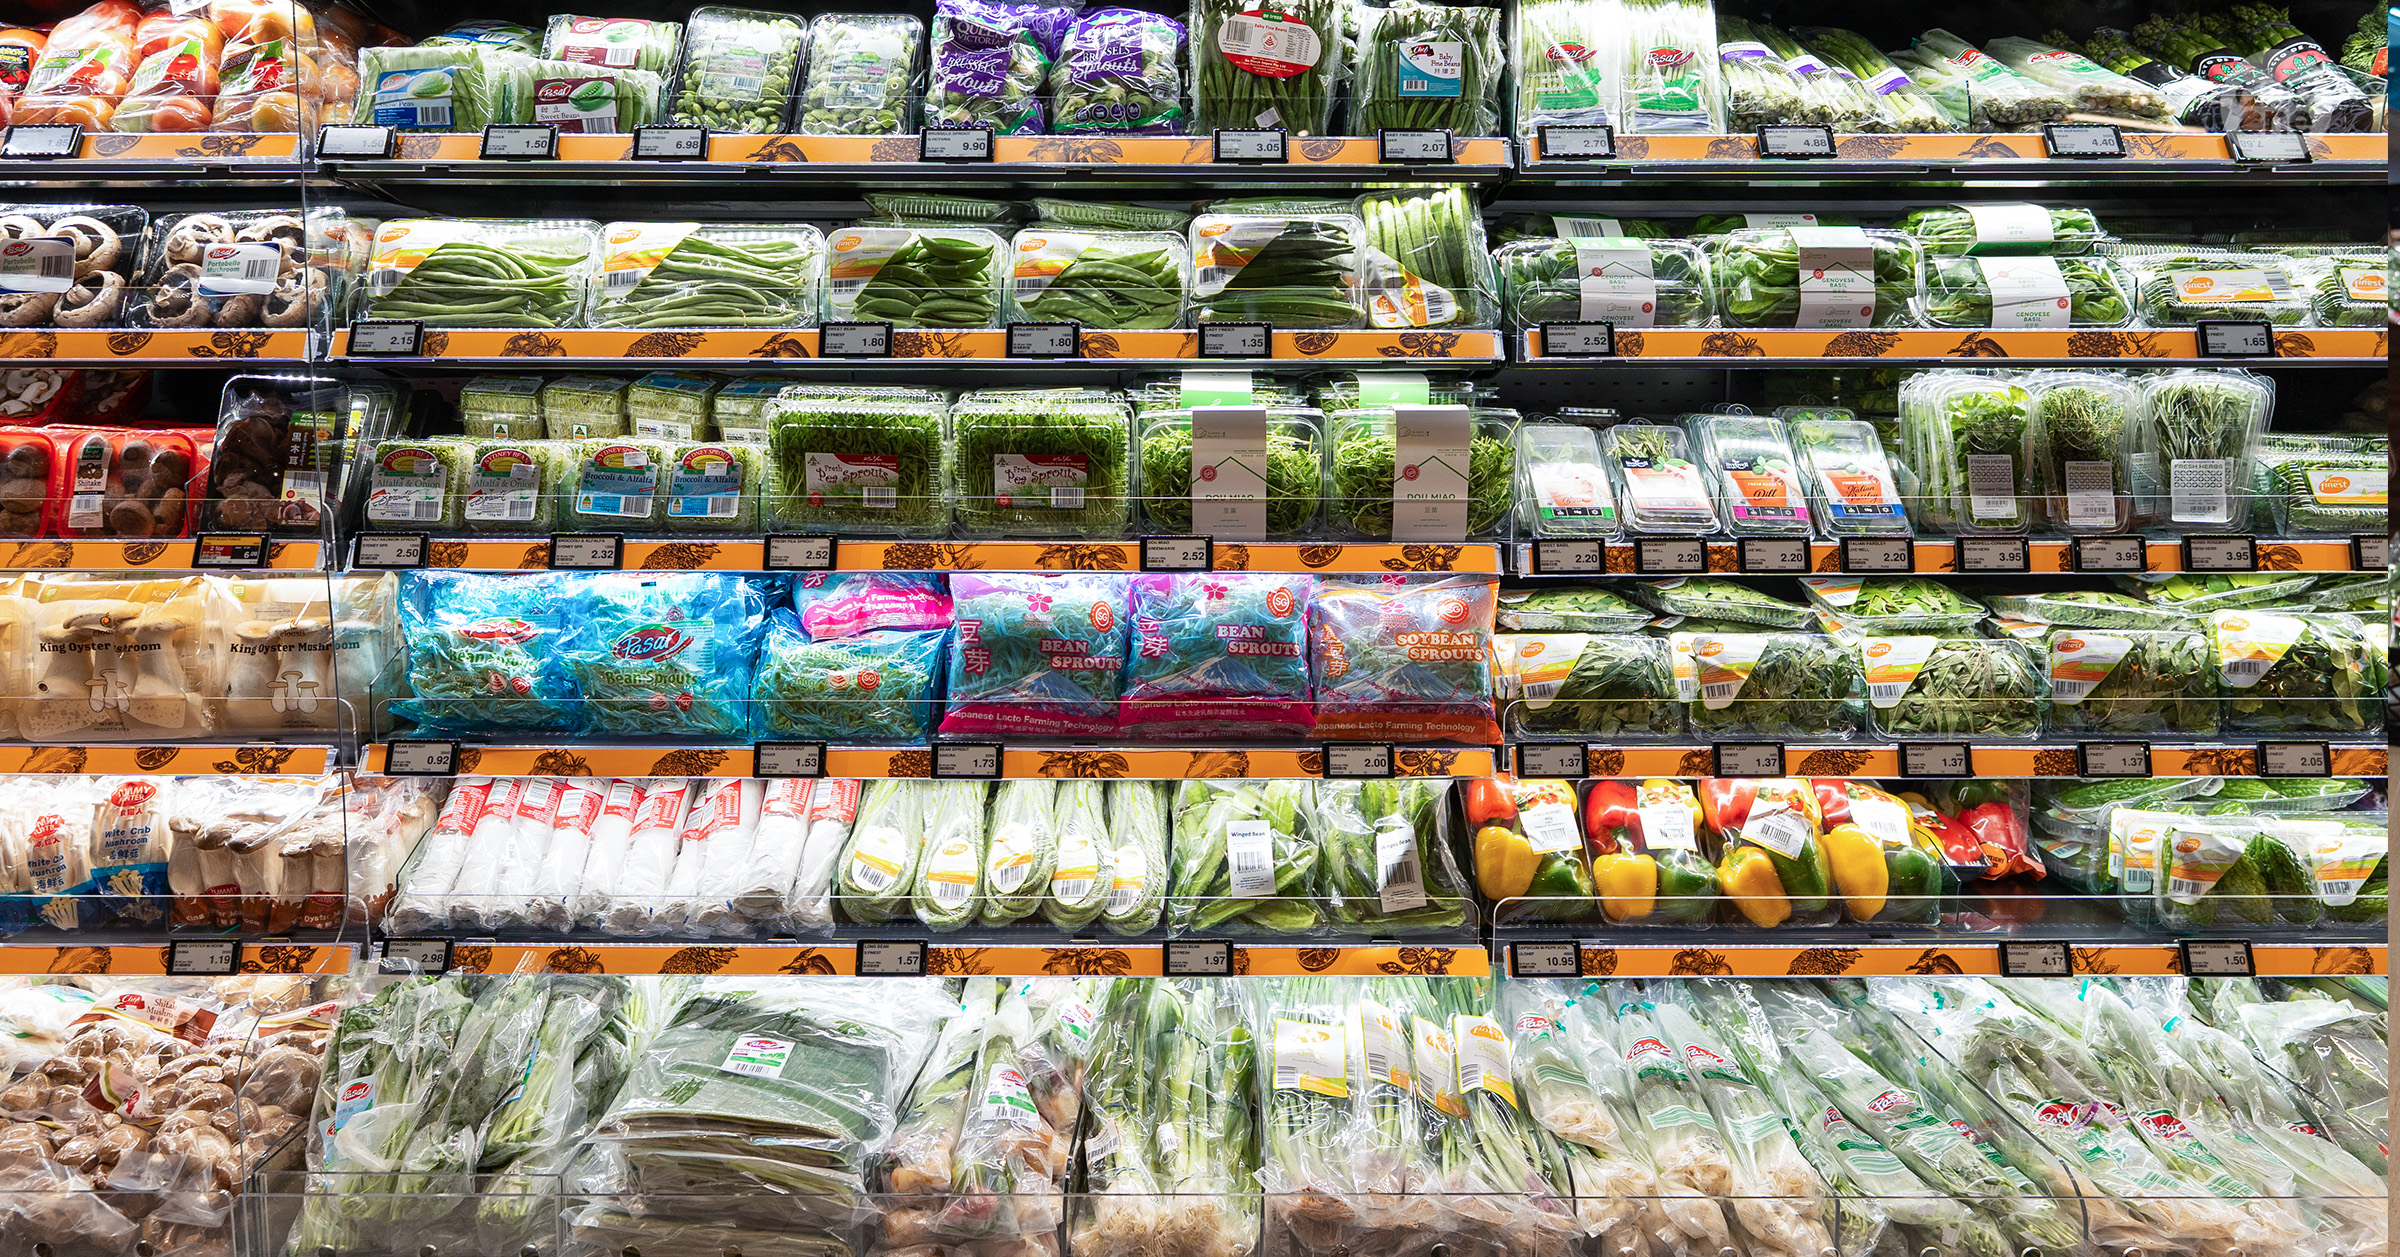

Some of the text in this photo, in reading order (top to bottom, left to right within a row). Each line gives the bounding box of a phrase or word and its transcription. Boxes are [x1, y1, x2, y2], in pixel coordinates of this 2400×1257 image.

[958, 32, 1001, 46] VICTORIA
[1438, 53, 1453, 62] Baby
[1648, 51, 1686, 65] Pasar
[946, 56, 997, 76] BRUSSELS
[1072, 57, 1138, 79] Sprouts
[1430, 60, 1443, 68] Fine
[540, 112, 561, 120] Sweet
[47, 138, 69, 147] 1.85
[362, 139, 384, 148] 1.50
[524, 140, 548, 149] 1.50
[675, 140, 699, 150] 6.98
[962, 142, 986, 151] 9.90
[1256, 143, 1279, 152] 3.05
[1421, 143, 1445, 152] 2.07
[1583, 139, 1607, 148] 2.70
[1803, 138, 1827, 147] 4.88
[2091, 138, 2115, 147] 4.40
[836, 239, 859, 249] finest
[1021, 240, 1045, 250] finest
[3, 257, 36, 266] Portobello
[207, 260, 241, 268] Portobello
[3, 263, 36, 271] Mushroom
[2183, 280, 2211, 290] finest
[2352, 278, 2383, 288] finest
[390, 336, 413, 345] 2.15
[862, 338, 884, 347] 1.80
[1049, 338, 1072, 347] 1.80
[1240, 339, 1263, 348] 1.35
[1583, 337, 1607, 346] 2.52
[2243, 338, 2266, 347] 1.65
[288, 432, 303, 466] 黑木耳
[824, 465, 843, 474] Fresh
[1013, 465, 1032, 475] Fresh
[585, 472, 653, 484] Broccoli & Alfalfa
[675, 475, 703, 483] Broccoli
[713, 475, 738, 484] Alfalfa
[815, 467, 889, 484] Pea Sprouts
[1004, 468, 1077, 486] Pea Sprouts
[77, 478, 102, 488] Shiitake
[376, 479, 441, 489] Alfalfa & Onion
[474, 479, 535, 489] Alfalfa & Onion
[2320, 480, 2348, 491] finest
[1758, 488, 1782, 502] Dill
[1846, 485, 1875, 495] Italian
[396, 548, 419, 558] 2.50
[590, 550, 614, 559] 2.32
[805, 550, 828, 560] 2.52
[1181, 552, 1205, 561] 2.52
[1677, 553, 1700, 563] 2.20
[1780, 553, 1803, 562] 2.20
[1883, 553, 1906, 562] 2.20
[1999, 552, 2022, 562] 3.95
[2115, 552, 2139, 562] 3.95
[2226, 552, 2249, 561] 3.95
[1574, 554, 1598, 563] 2.20
[871, 594, 907, 603] Farming
[1276, 597, 1288, 607] SG
[1097, 611, 1109, 622] SG
[1216, 625, 1265, 640] BEAN
[620, 628, 682, 657] Pasar
[1396, 632, 1475, 648] SOYBEAN
[39, 642, 111, 655] King Oyster
[230, 643, 295, 656] King Oyster
[958, 620, 992, 675] 豆芽
[1040, 639, 1089, 654] BEAN
[1227, 641, 1301, 657] SPROUTS
[1521, 644, 1544, 655] finest
[1699, 645, 1724, 656] finest
[1868, 645, 1890, 655] finest
[449, 649, 480, 664] Bean
[814, 646, 849, 660] Bean
[1409, 646, 1484, 663] SPROUTS
[1051, 655, 1125, 671] SPROUTS
[605, 669, 699, 688] Bean Sprouts
[792, 676, 815, 689] 200g
[950, 710, 1114, 732] Japanese Lacto Farming Technology
[1314, 720, 1476, 734] Japanese Lacto Farming Technology
[426, 755, 449, 765] 0.92
[795, 758, 817, 767] 1.53
[973, 759, 995, 768] 1.73
[1364, 758, 1387, 768] 2.00
[1558, 758, 1581, 768] 1.37
[1755, 758, 1777, 767] 1.37
[1941, 758, 1964, 767] 1.37
[2121, 758, 2143, 767] 1.37
[2300, 757, 2323, 767] 2.05
[1230, 831, 1266, 840] Winged Bean
[105, 837, 149, 848] Mushroom
[209, 955, 231, 964] 1.19
[421, 953, 444, 963] 2.98
[897, 956, 919, 966] 1.57
[1203, 956, 1225, 965] 1.97
[1546, 956, 1574, 966] 10.95
[2041, 956, 2064, 966] 4.17
[2223, 956, 2246, 965] 1.50
